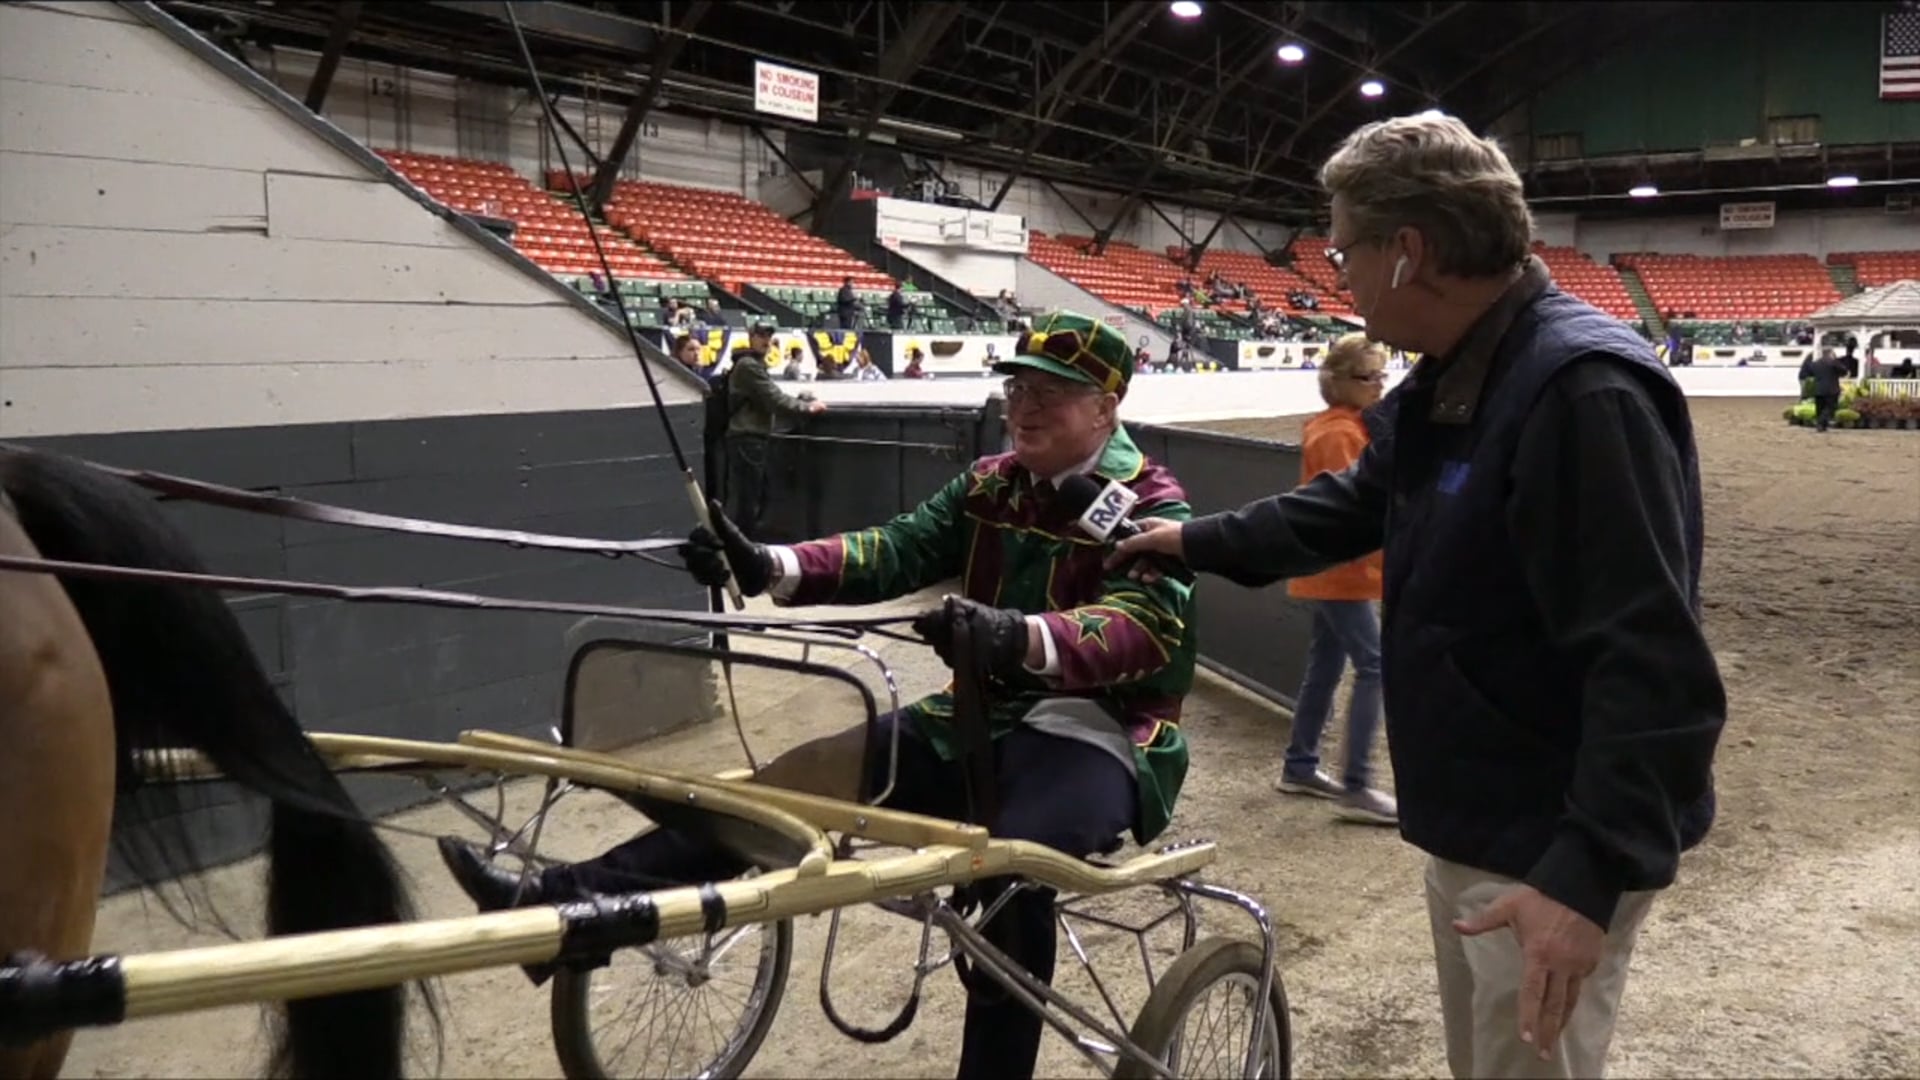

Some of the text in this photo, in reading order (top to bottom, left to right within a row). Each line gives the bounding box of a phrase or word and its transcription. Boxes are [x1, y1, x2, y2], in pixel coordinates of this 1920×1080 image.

[372, 77, 393, 97] 12
[759, 68, 815, 90] NO SMOKING
[759, 82, 815, 104] IN COLISEUM
[643, 121, 658, 138] 13
